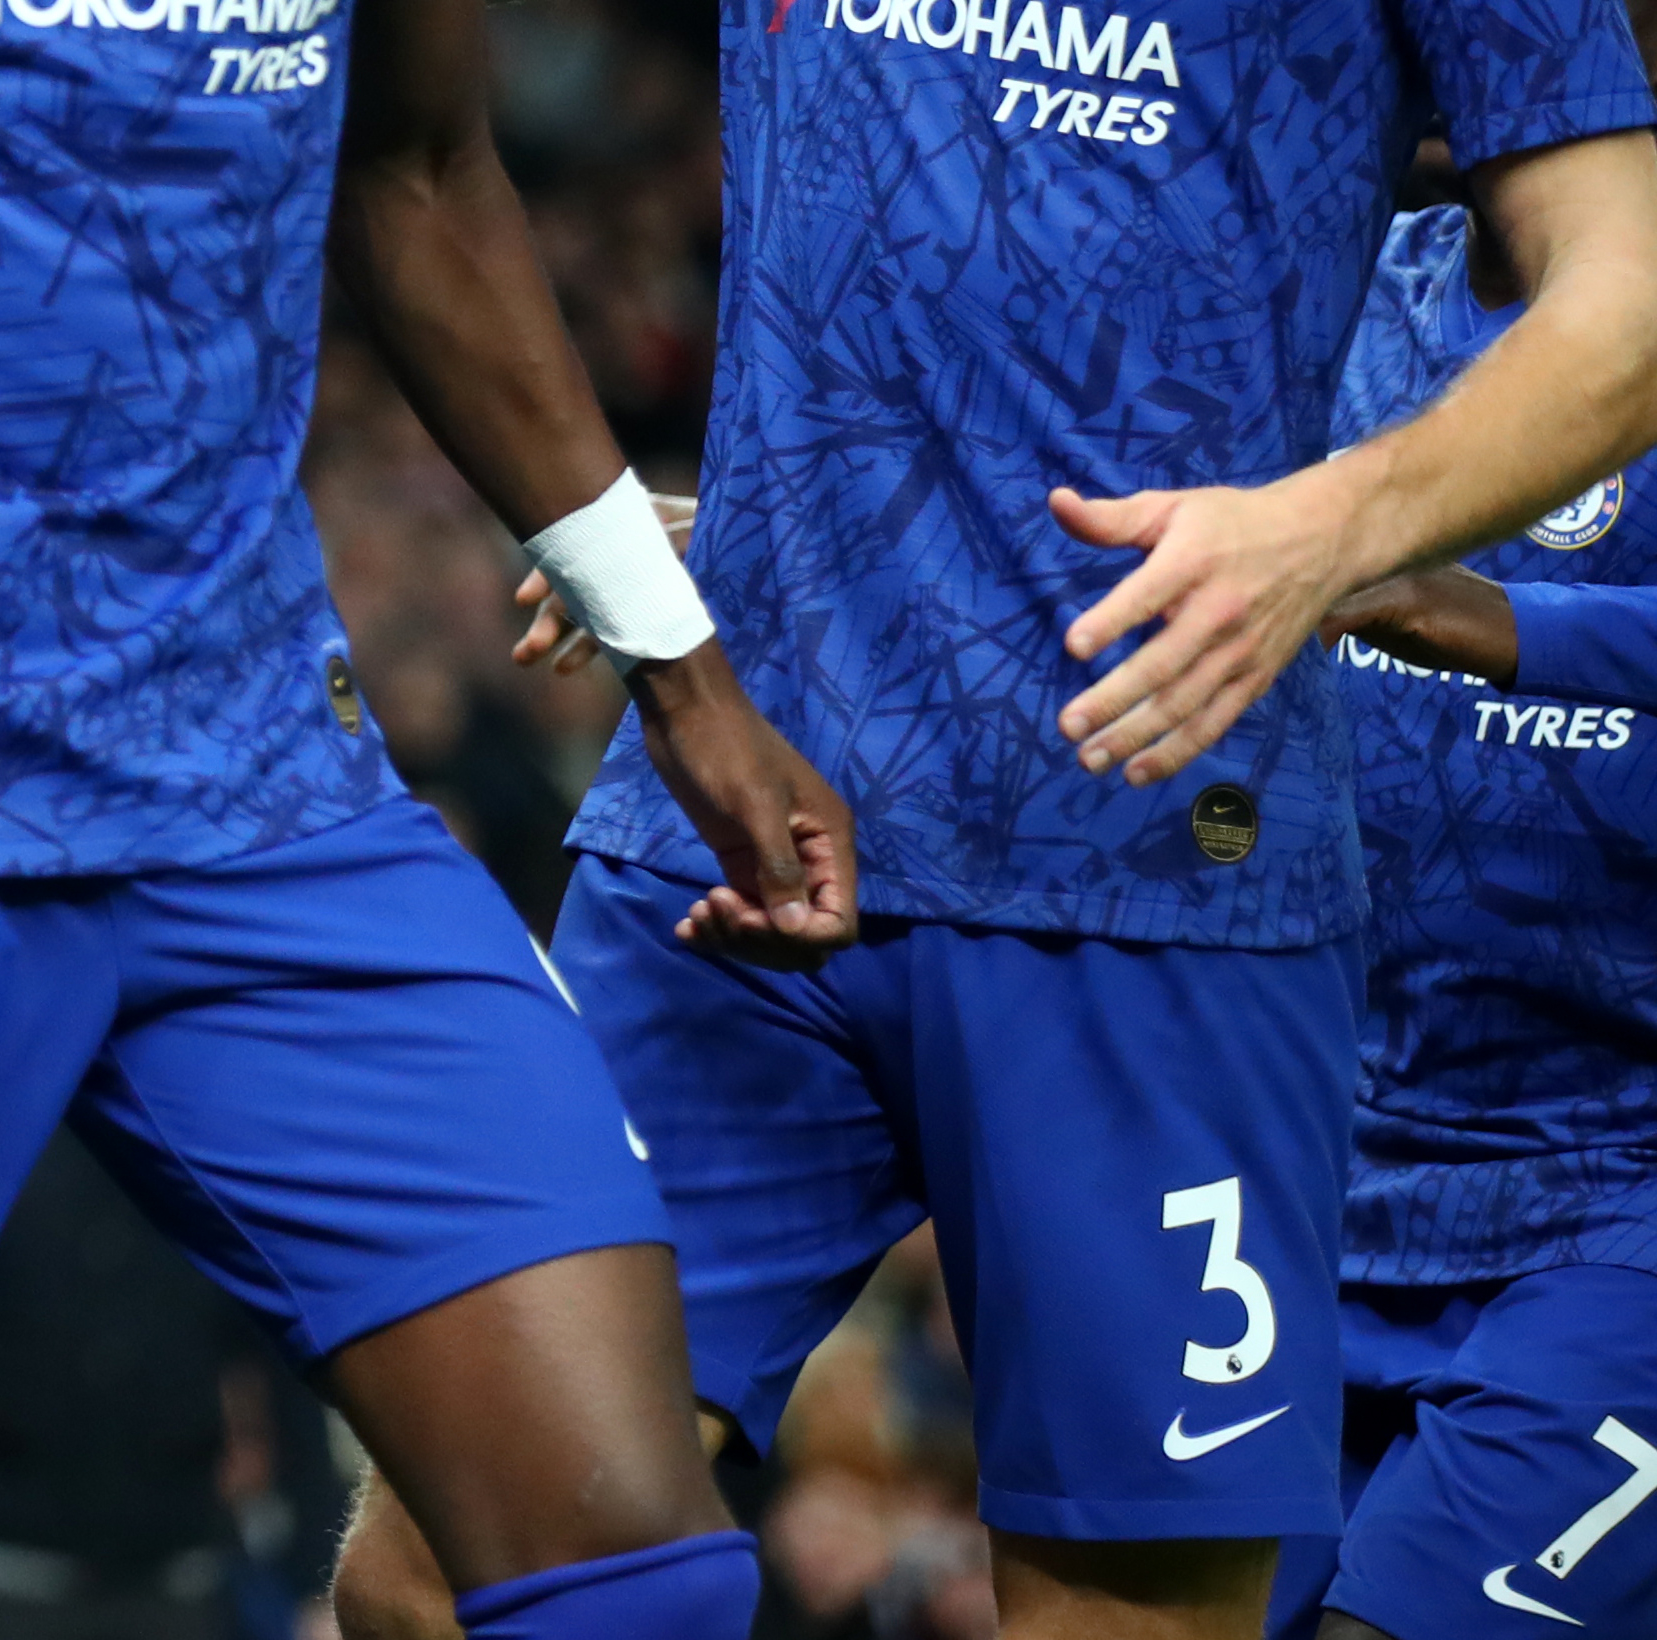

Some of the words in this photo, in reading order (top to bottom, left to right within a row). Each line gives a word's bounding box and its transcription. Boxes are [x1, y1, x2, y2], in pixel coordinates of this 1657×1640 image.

[202, 35, 328, 95] TYRES
[992, 78, 1176, 147] TYRES
[1474, 700, 1635, 750] TYRES
[1162, 1176, 1277, 1385] 3
[1534, 1413, 1657, 1581] 7
